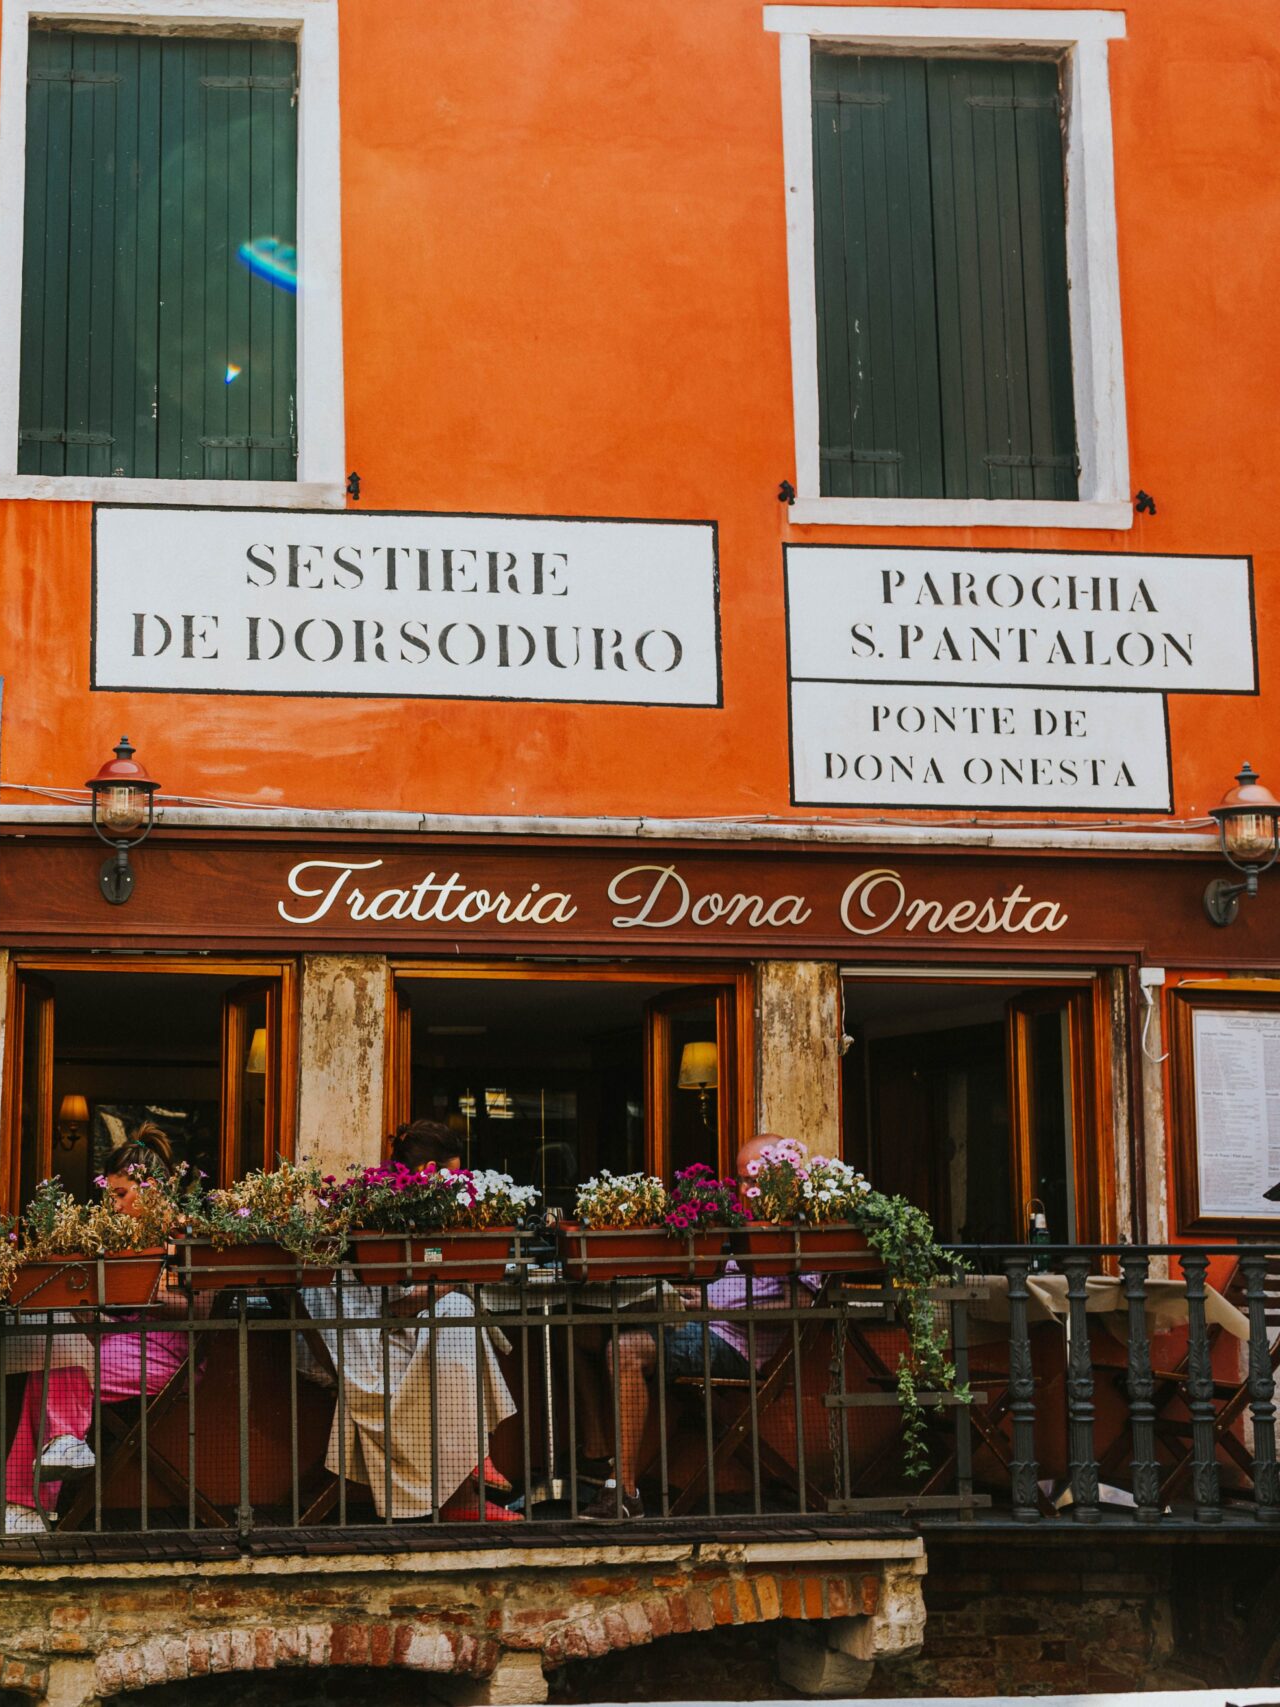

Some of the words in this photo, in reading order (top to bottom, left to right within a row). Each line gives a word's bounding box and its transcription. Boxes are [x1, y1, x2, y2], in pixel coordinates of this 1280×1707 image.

[246, 543, 568, 597] SESTIERE
[881, 569, 1159, 613] PAROCHIA
[131, 611, 219, 660] DE
[245, 615, 683, 674] DORSODURO
[850, 622, 884, 660] S.
[899, 623, 1193, 668] PANTALON
[872, 704, 1016, 735] PONTE
[1033, 708, 1087, 738] DE
[824, 752, 945, 784] DONA
[962, 757, 1137, 788] ONESTA
[277, 859, 578, 924] Trattoria
[607, 865, 812, 929] Dona
[839, 868, 1069, 935] Onesta
